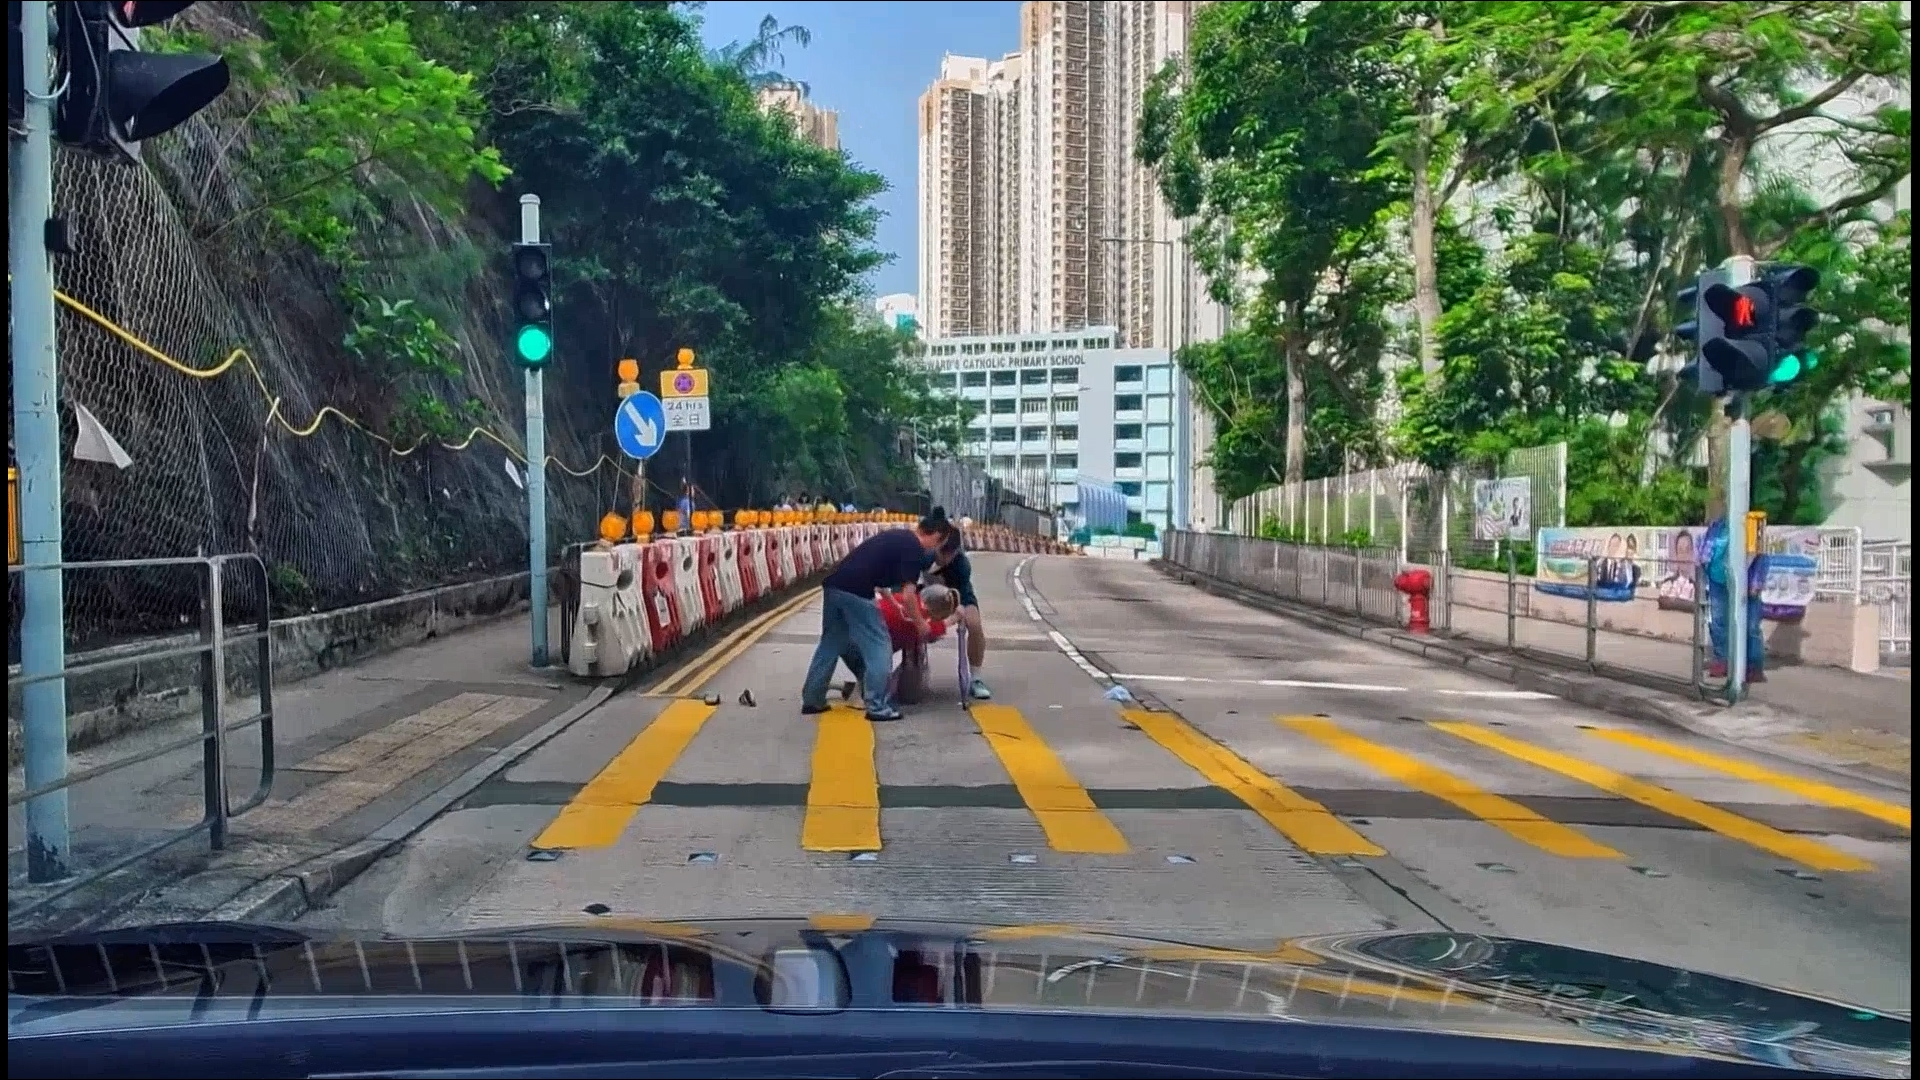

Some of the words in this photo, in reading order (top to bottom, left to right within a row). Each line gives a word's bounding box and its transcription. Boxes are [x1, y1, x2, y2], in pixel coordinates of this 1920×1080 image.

[963, 356, 1006, 369] CATHOLIC
[1009, 355, 1048, 368] PRIMARY
[1050, 354, 1086, 366] SCHOOL
[667, 401, 682, 410] 24
[685, 401, 703, 410] hrs
